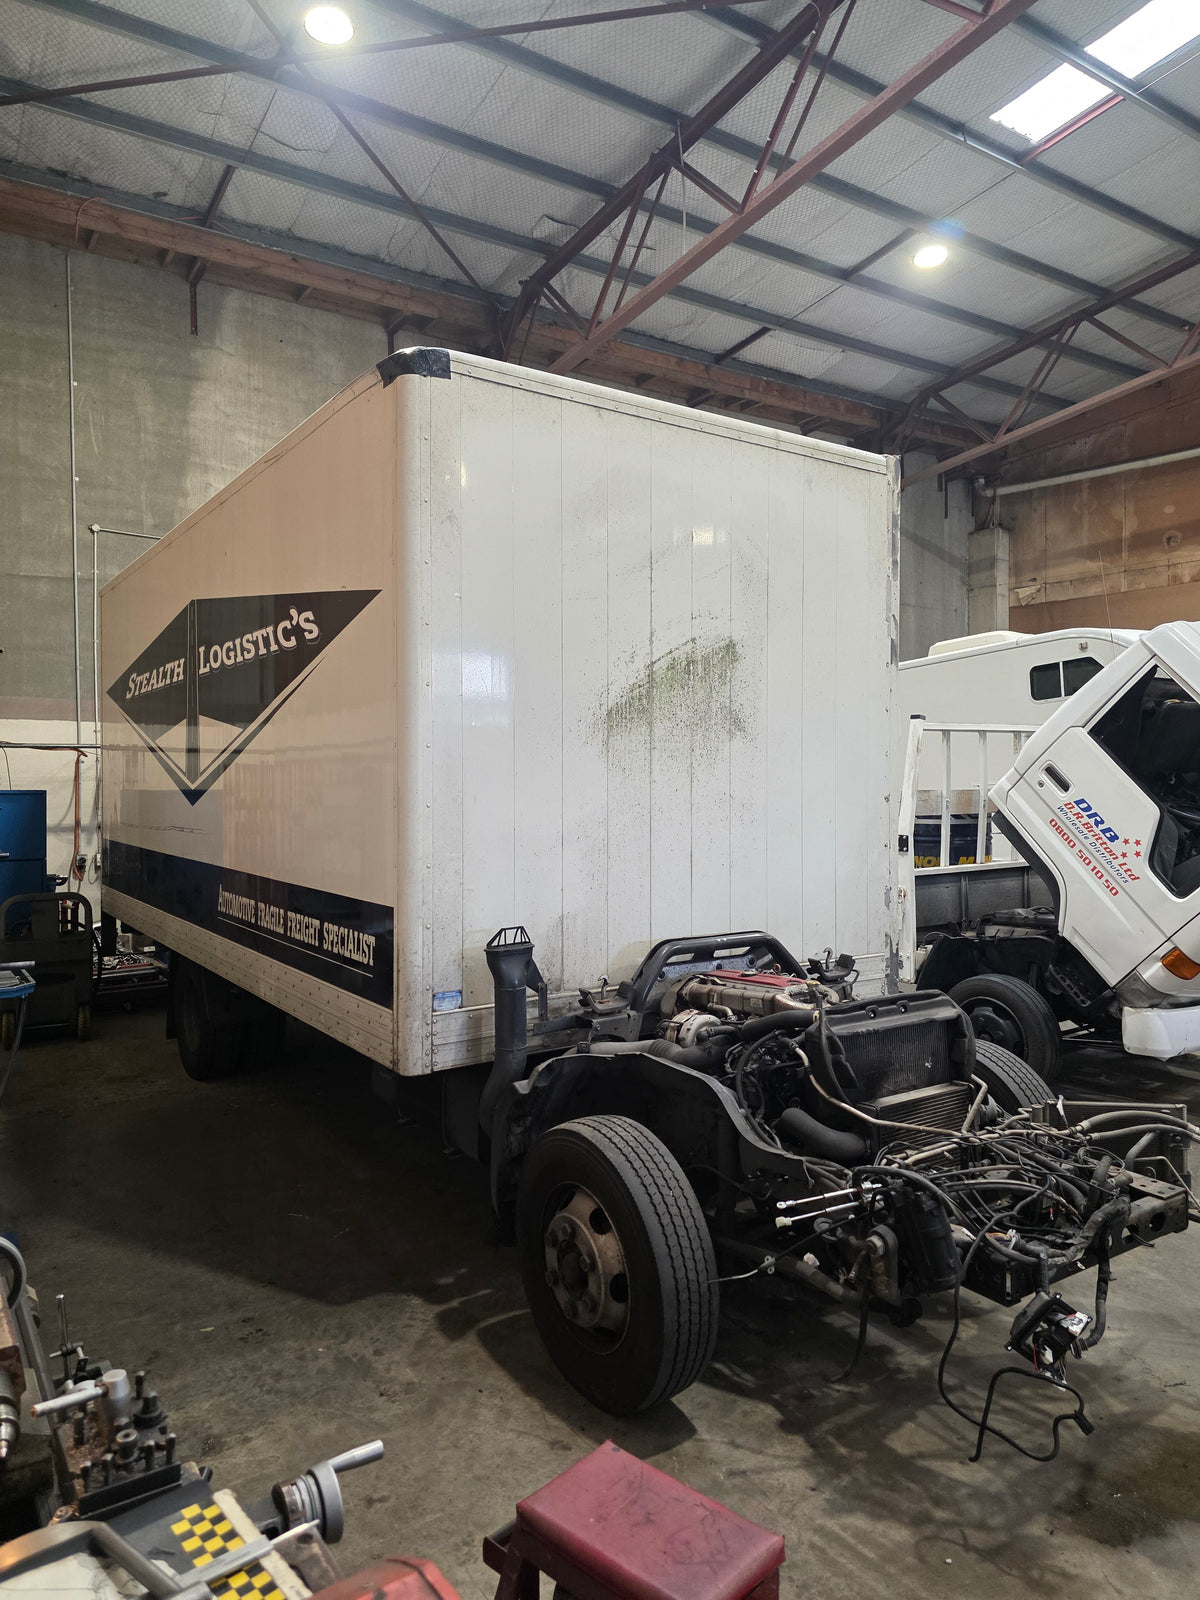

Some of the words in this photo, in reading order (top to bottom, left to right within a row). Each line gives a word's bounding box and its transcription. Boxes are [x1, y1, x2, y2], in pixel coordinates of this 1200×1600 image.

[125, 657, 185, 699] STEALTH
[198, 607, 319, 675] LOGISTIC'S
[1049, 818, 1077, 849] 0800
[1057, 805, 1090, 840] Wholesale
[1089, 841, 1129, 884] Distributors
[1073, 798, 1120, 843] DRB
[1118, 862, 1141, 881] Ltd
[217, 884, 256, 924] AUTOMOTIVE
[257, 902, 285, 934] FRAGILE
[287, 911, 321, 947] FREIGHT
[323, 921, 376, 966] SPECIALIST
